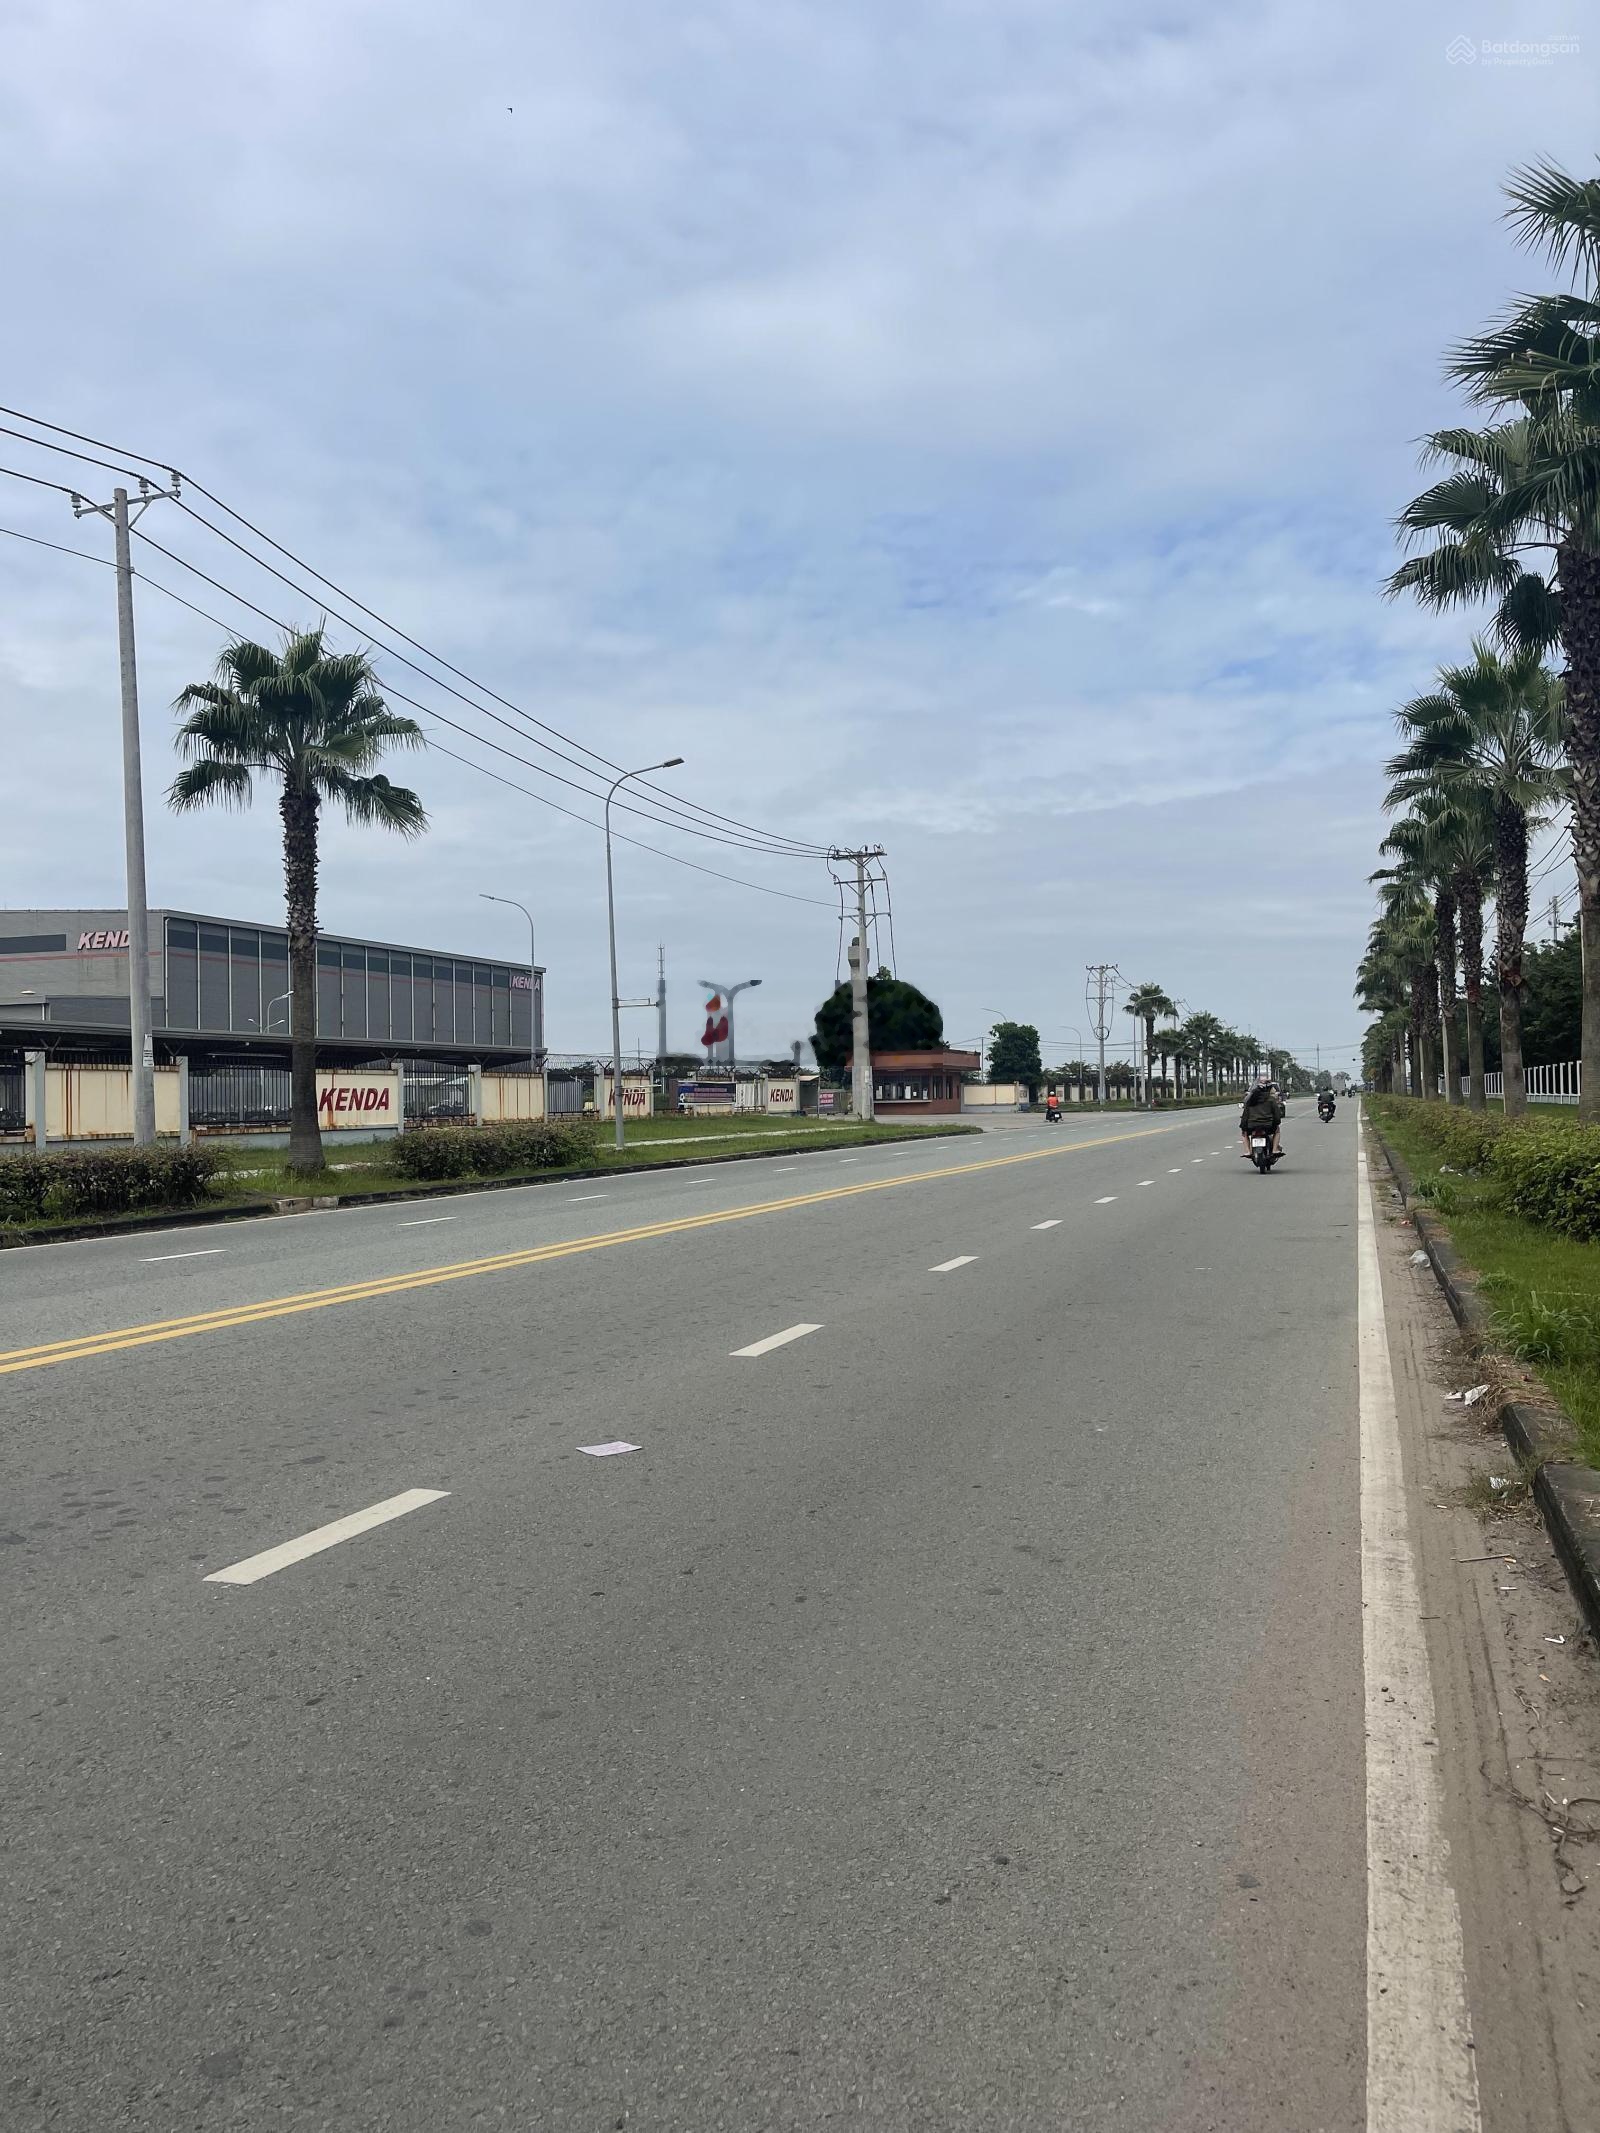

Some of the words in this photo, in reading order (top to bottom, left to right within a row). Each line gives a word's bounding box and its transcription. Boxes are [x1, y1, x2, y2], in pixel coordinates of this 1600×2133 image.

[77, 930, 130, 950] KEND
[318, 1087, 390, 1112] KENDA
[608, 1088, 646, 1106] KNDA
[769, 1088, 794, 1103] KENDA
